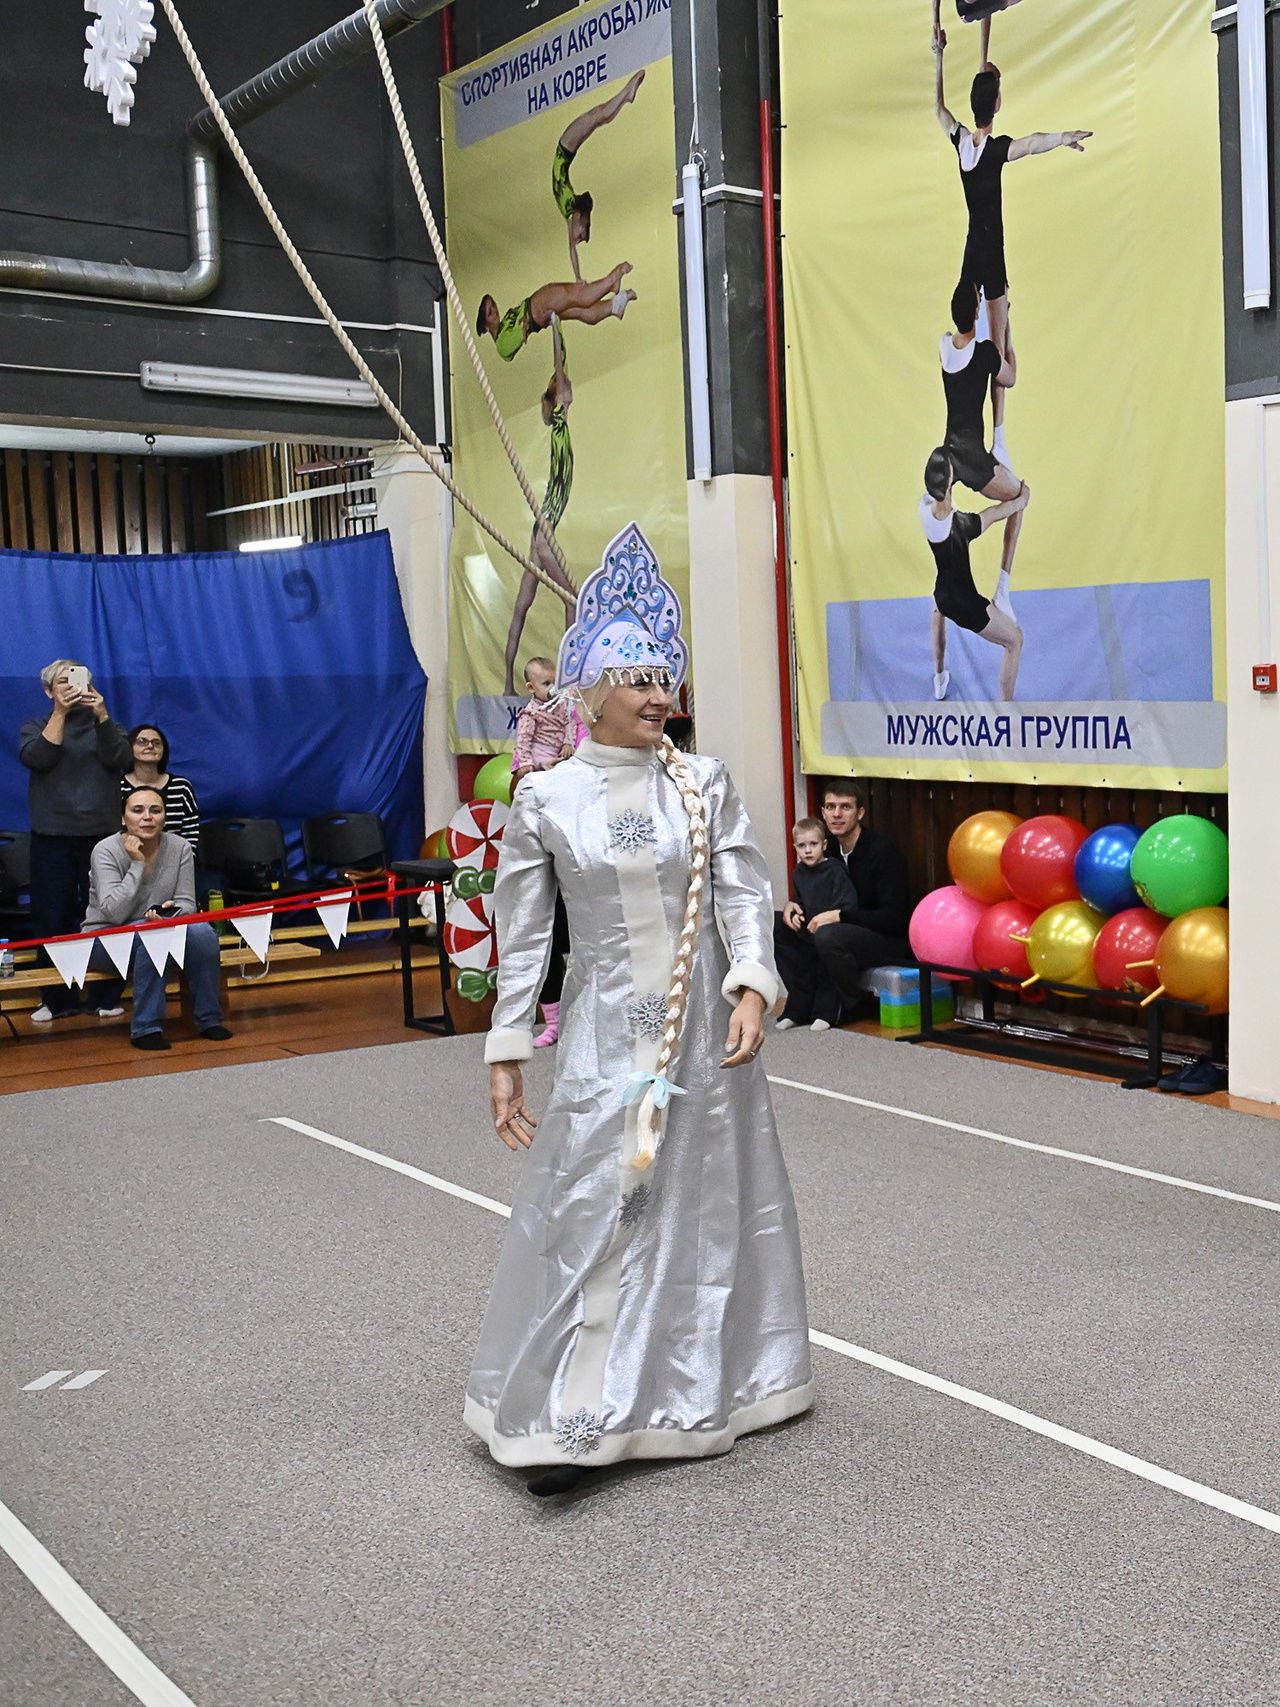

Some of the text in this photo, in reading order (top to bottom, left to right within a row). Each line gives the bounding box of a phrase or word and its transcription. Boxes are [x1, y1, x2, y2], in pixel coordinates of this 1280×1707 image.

[461, 35, 563, 107] СПОРТИВНАЯ
[527, 53, 608, 114] НА КОВРЕ
[887, 715, 1132, 749] МУЖСКАЯ ГРУППА
